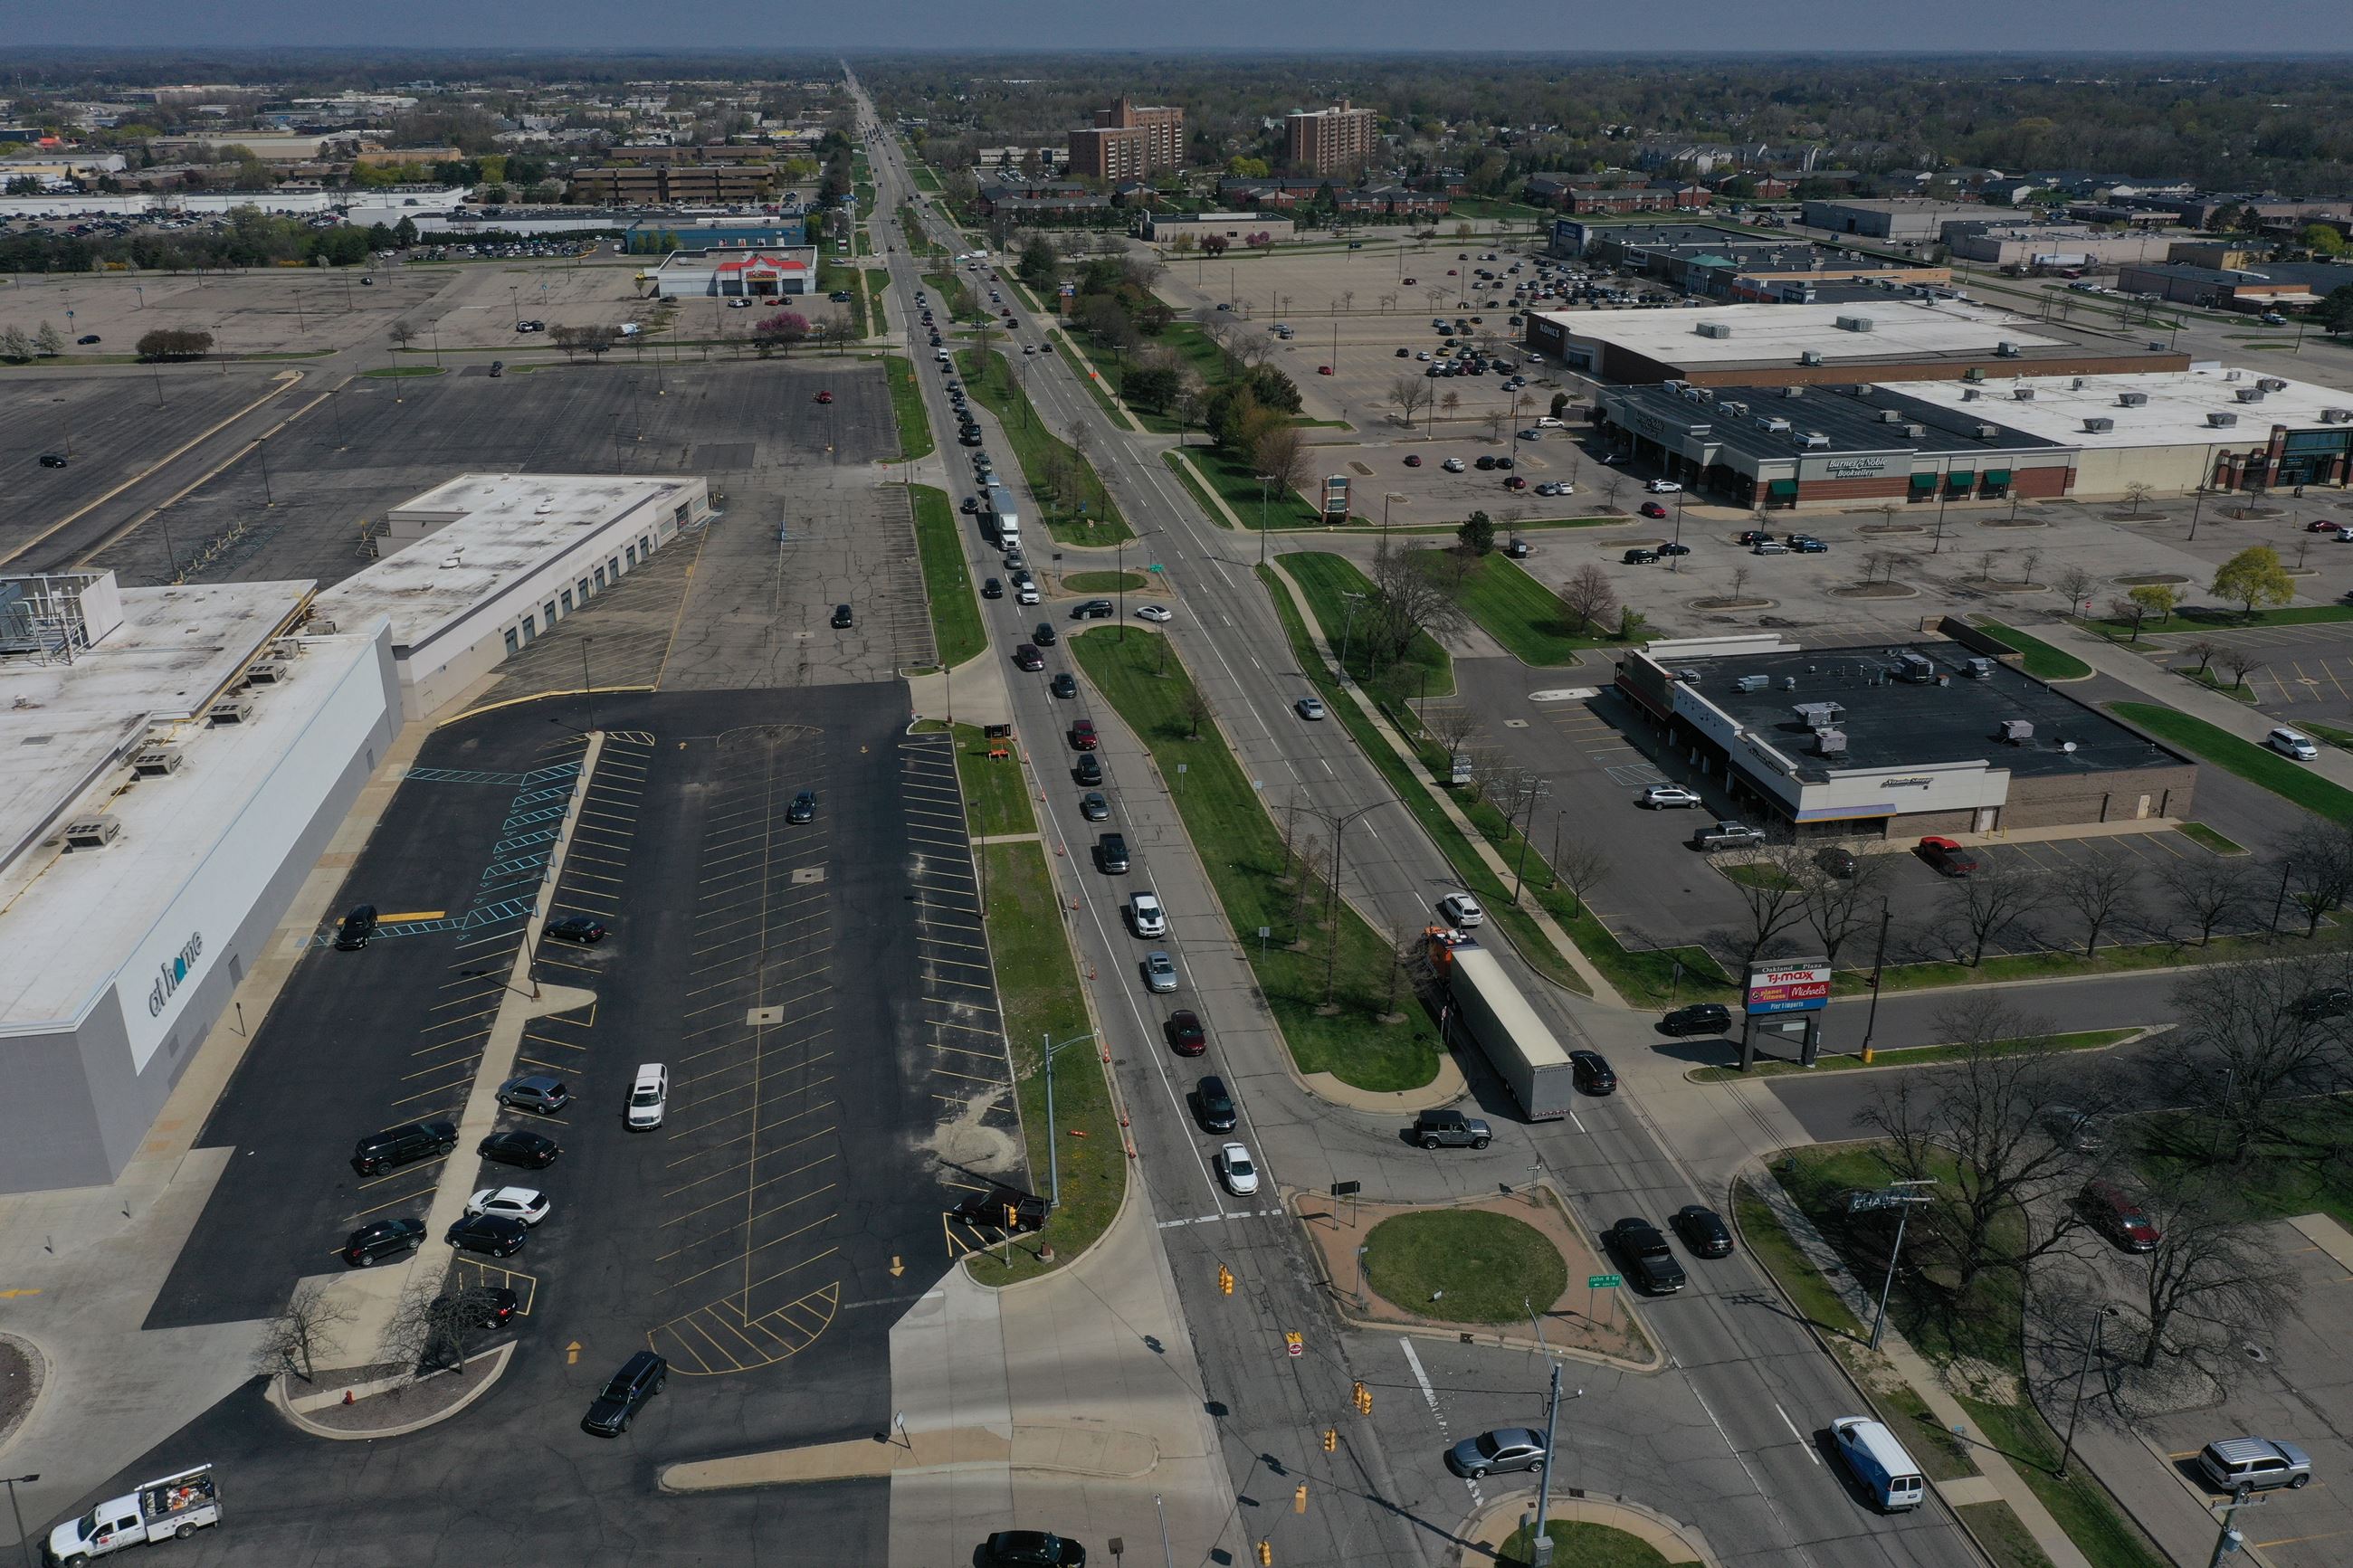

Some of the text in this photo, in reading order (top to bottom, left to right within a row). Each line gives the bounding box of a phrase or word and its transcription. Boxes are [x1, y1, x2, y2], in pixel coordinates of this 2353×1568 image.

[1828, 459, 1856, 469] Barnes
[1864, 456, 1887, 467] Noble
[1837, 469, 1876, 479] Booksellers
[1762, 965, 1794, 974] Oakland
[1760, 988, 1782, 997] planet
[1791, 984, 1826, 997] Michaels
